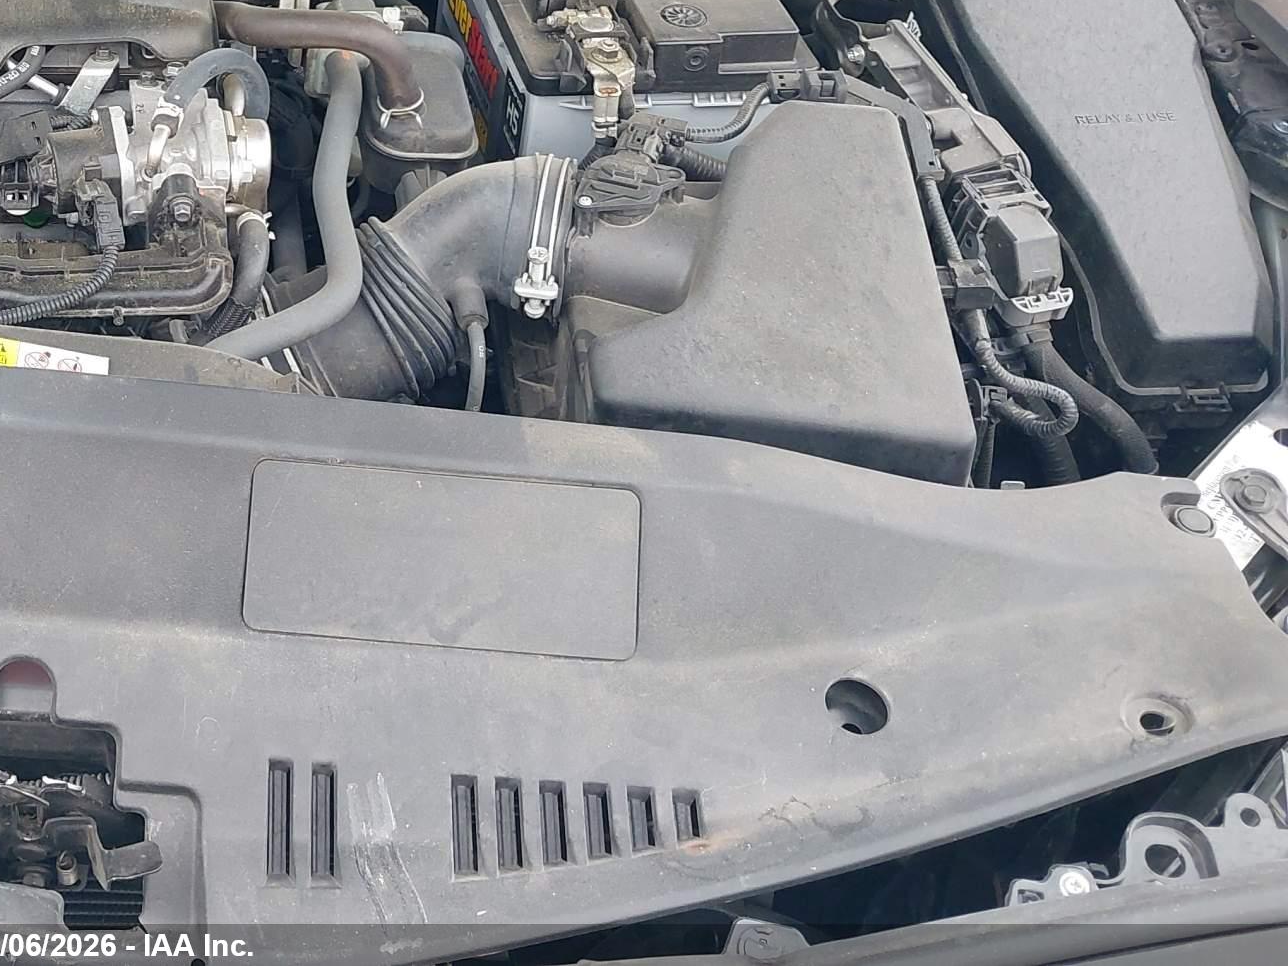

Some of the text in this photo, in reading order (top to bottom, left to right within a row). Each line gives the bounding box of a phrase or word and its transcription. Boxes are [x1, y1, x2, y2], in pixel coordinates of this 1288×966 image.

[1074, 111, 1176, 125] RELAY & FUSE
